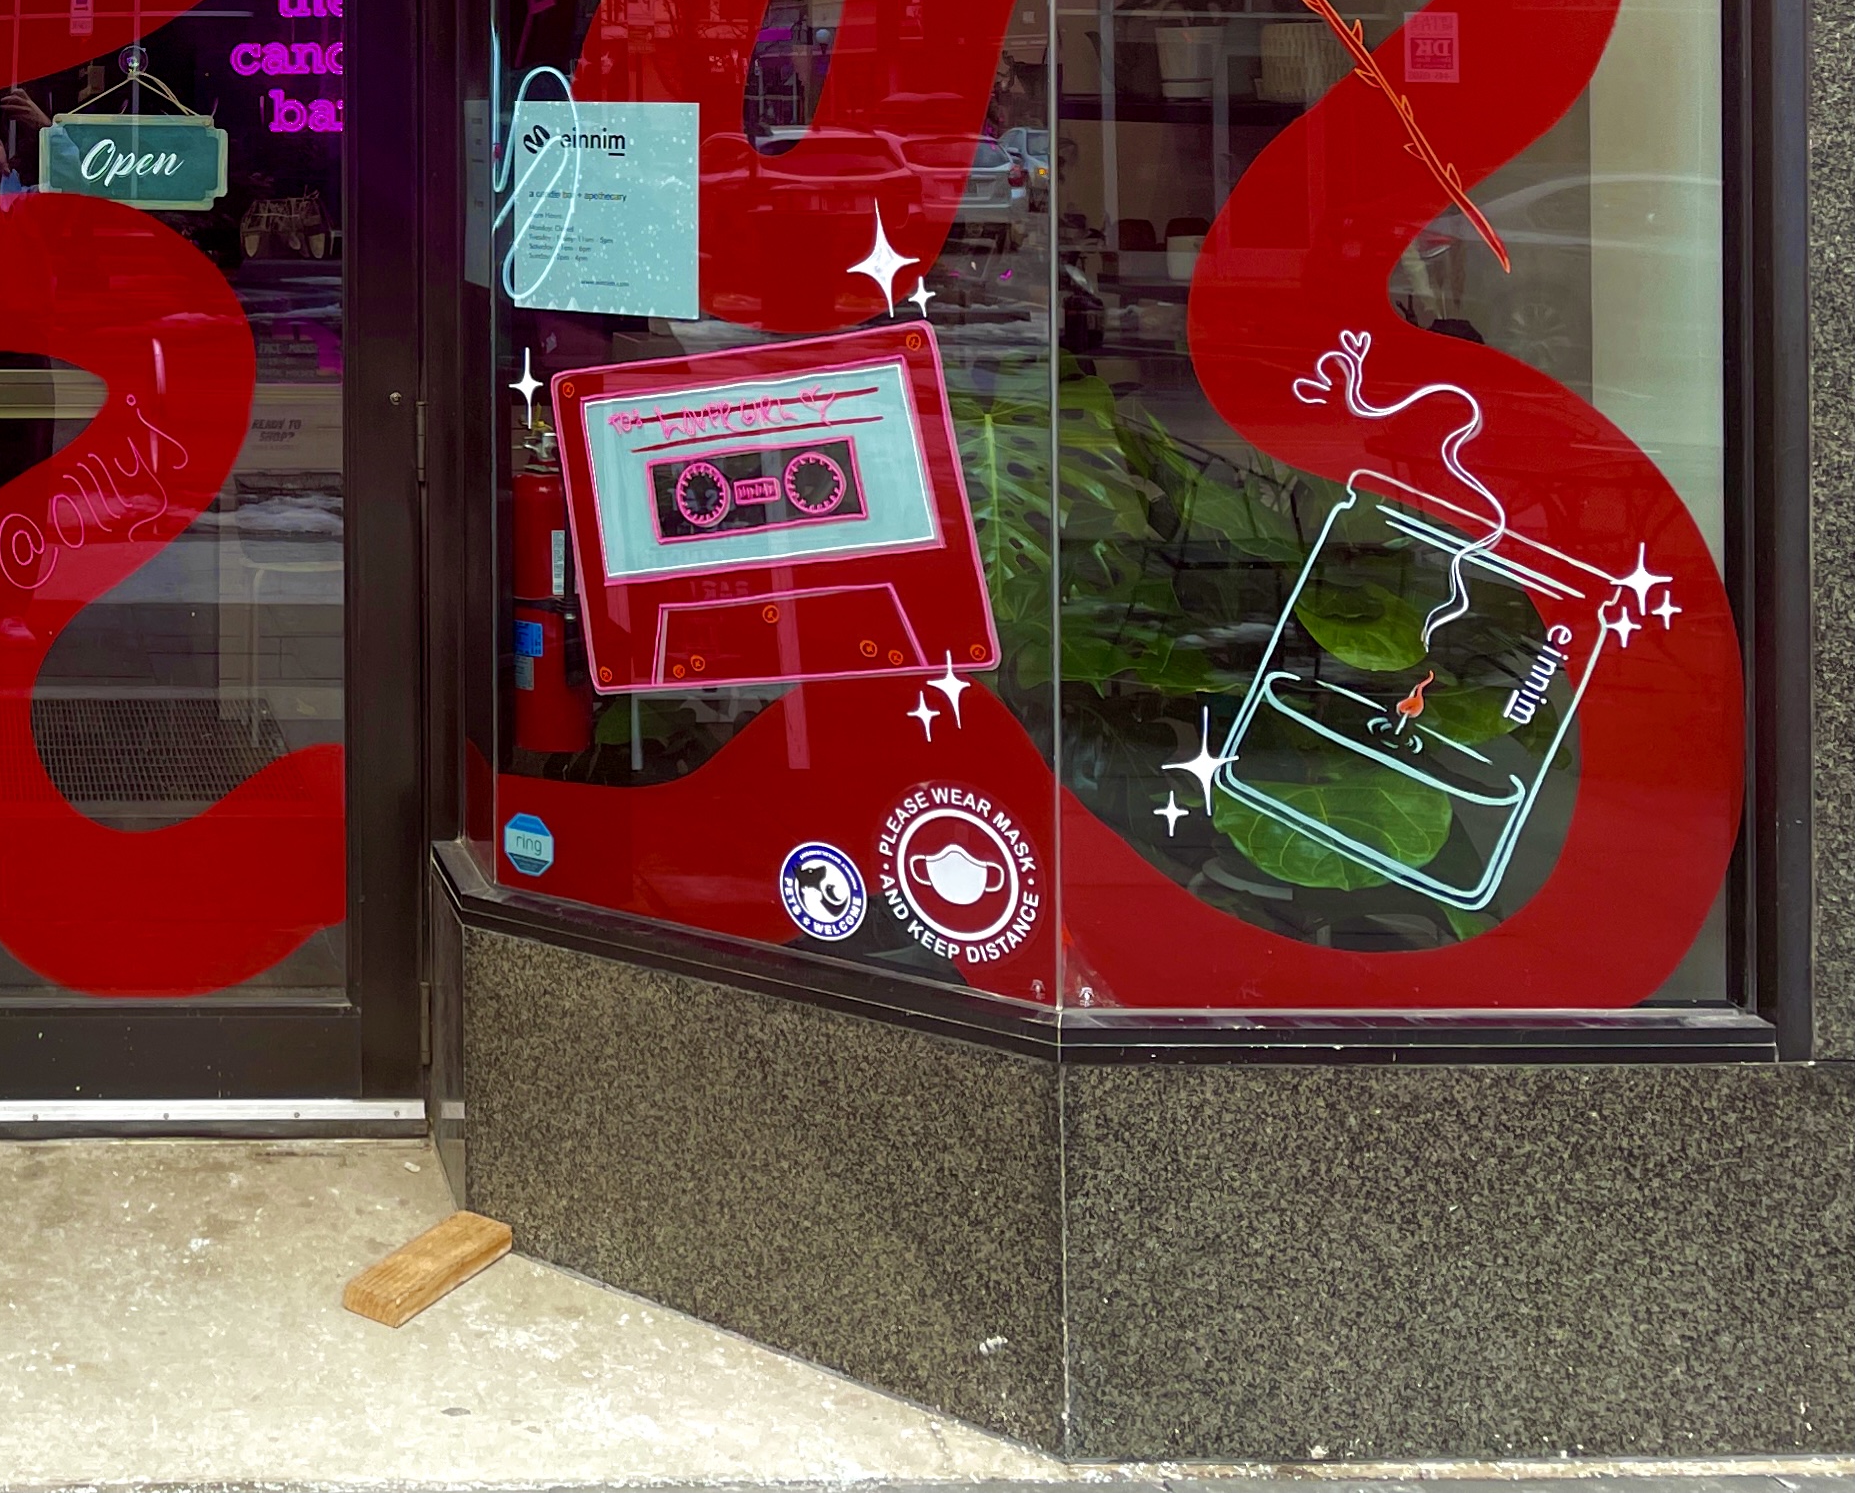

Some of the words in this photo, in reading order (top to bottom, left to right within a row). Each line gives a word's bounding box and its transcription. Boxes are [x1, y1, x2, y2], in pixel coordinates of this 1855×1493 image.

[268, 88, 343, 133] ba
[80, 138, 185, 187] Open
[560, 127, 625, 157] einnim
[1503, 624, 1573, 724] einnim
[516, 834, 542, 856] ring
[879, 791, 930, 856] PLEASE
[931, 787, 991, 817] WEAR
[992, 812, 1037, 873] MASK
[784, 877, 802, 915] PETS
[813, 896, 862, 935] WELCOME
[879, 874, 909, 920] AND
[907, 919, 960, 959] KEEP
[966, 891, 1040, 963] DISTANCE
